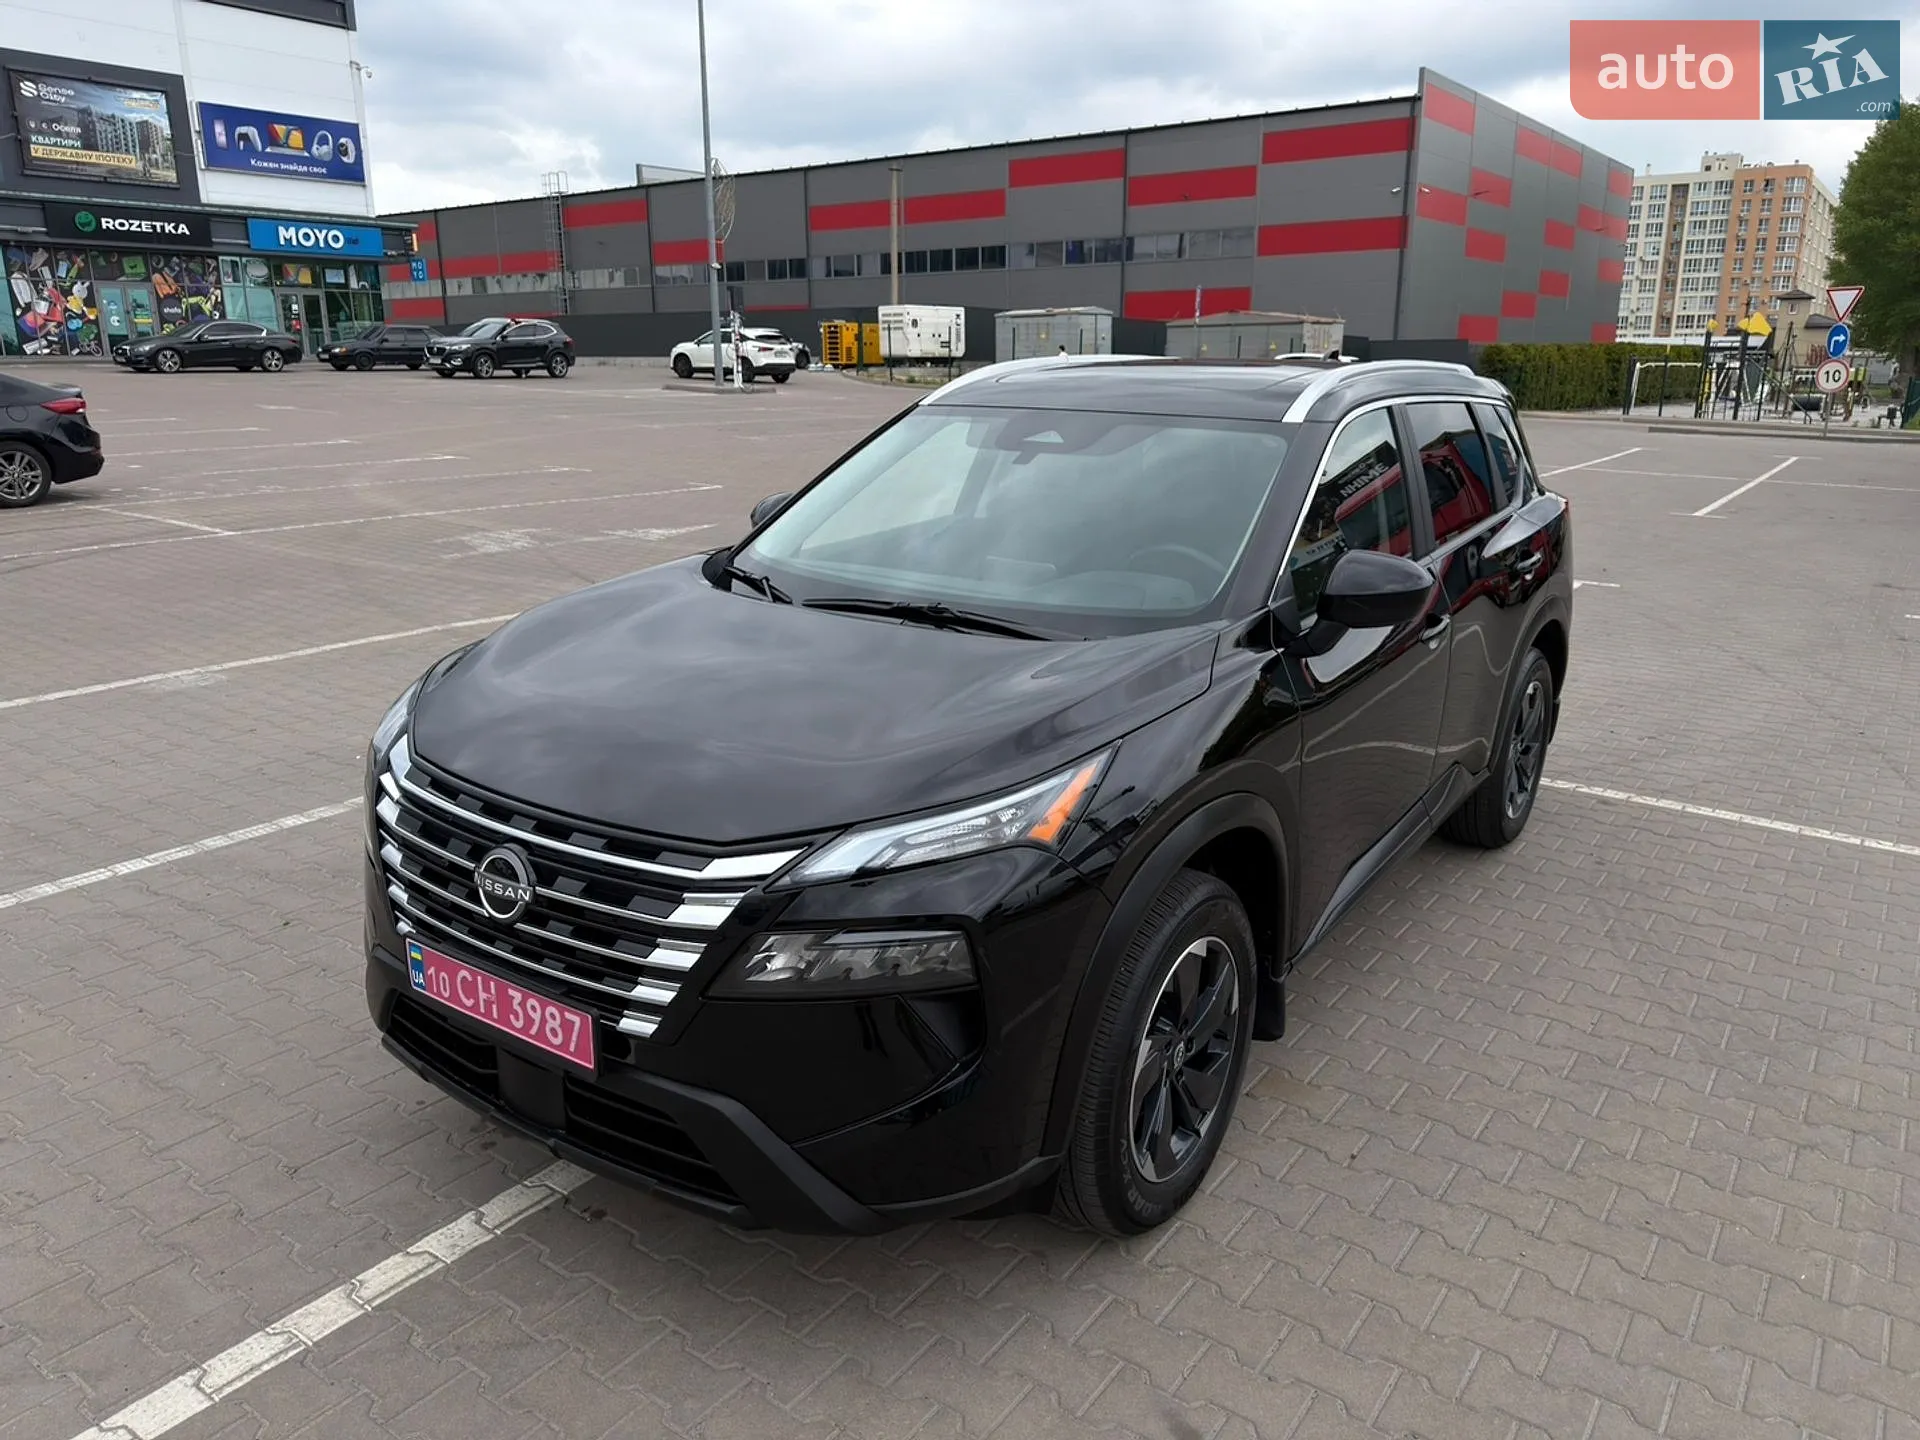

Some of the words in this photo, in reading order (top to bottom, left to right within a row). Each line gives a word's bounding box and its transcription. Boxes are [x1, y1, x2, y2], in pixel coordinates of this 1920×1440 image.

[250, 158, 279, 168] Кожен
[101, 217, 190, 235] ROZETKA
[278, 225, 345, 249] MOYO
[1824, 369, 1841, 383] 10
[474, 871, 530, 901] NISSAN
[411, 969, 425, 987] UA
[427, 966, 450, 998] 10
[456, 969, 499, 1020] CH
[507, 987, 582, 1053] 3987
